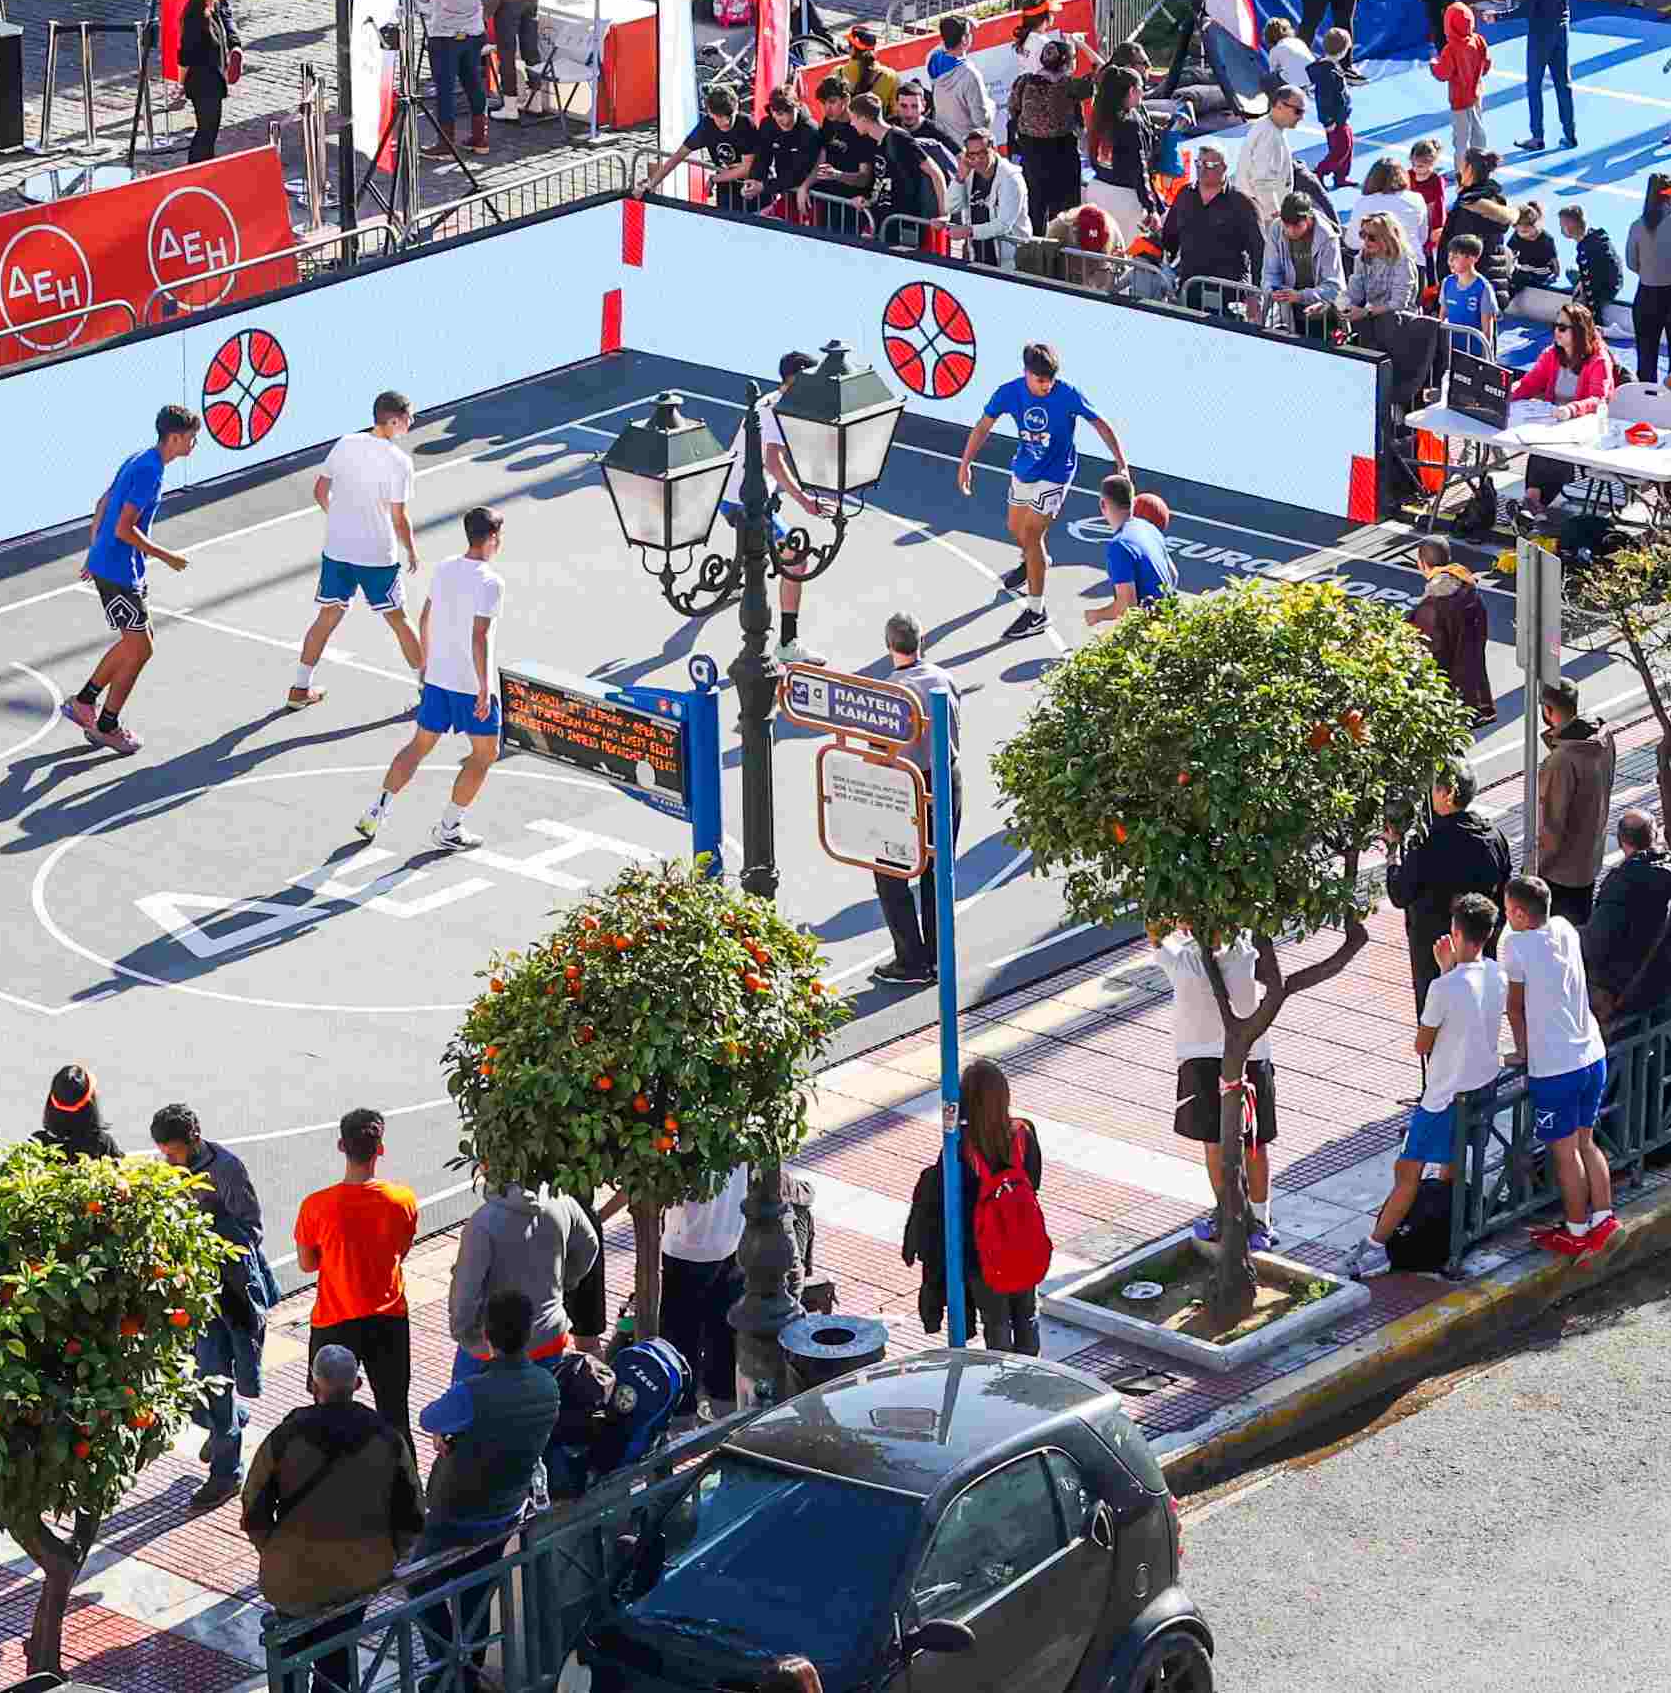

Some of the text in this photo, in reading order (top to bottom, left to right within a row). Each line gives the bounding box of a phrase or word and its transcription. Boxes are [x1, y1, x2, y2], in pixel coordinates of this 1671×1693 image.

[159, 227, 228, 271] ΔΕΗ
[8, 264, 79, 309] ΔΕΗ
[834, 688, 902, 715] ΠΛΑΤΕΙΑ
[834, 703, 900, 733] ΚΑΝΑΡΗ
